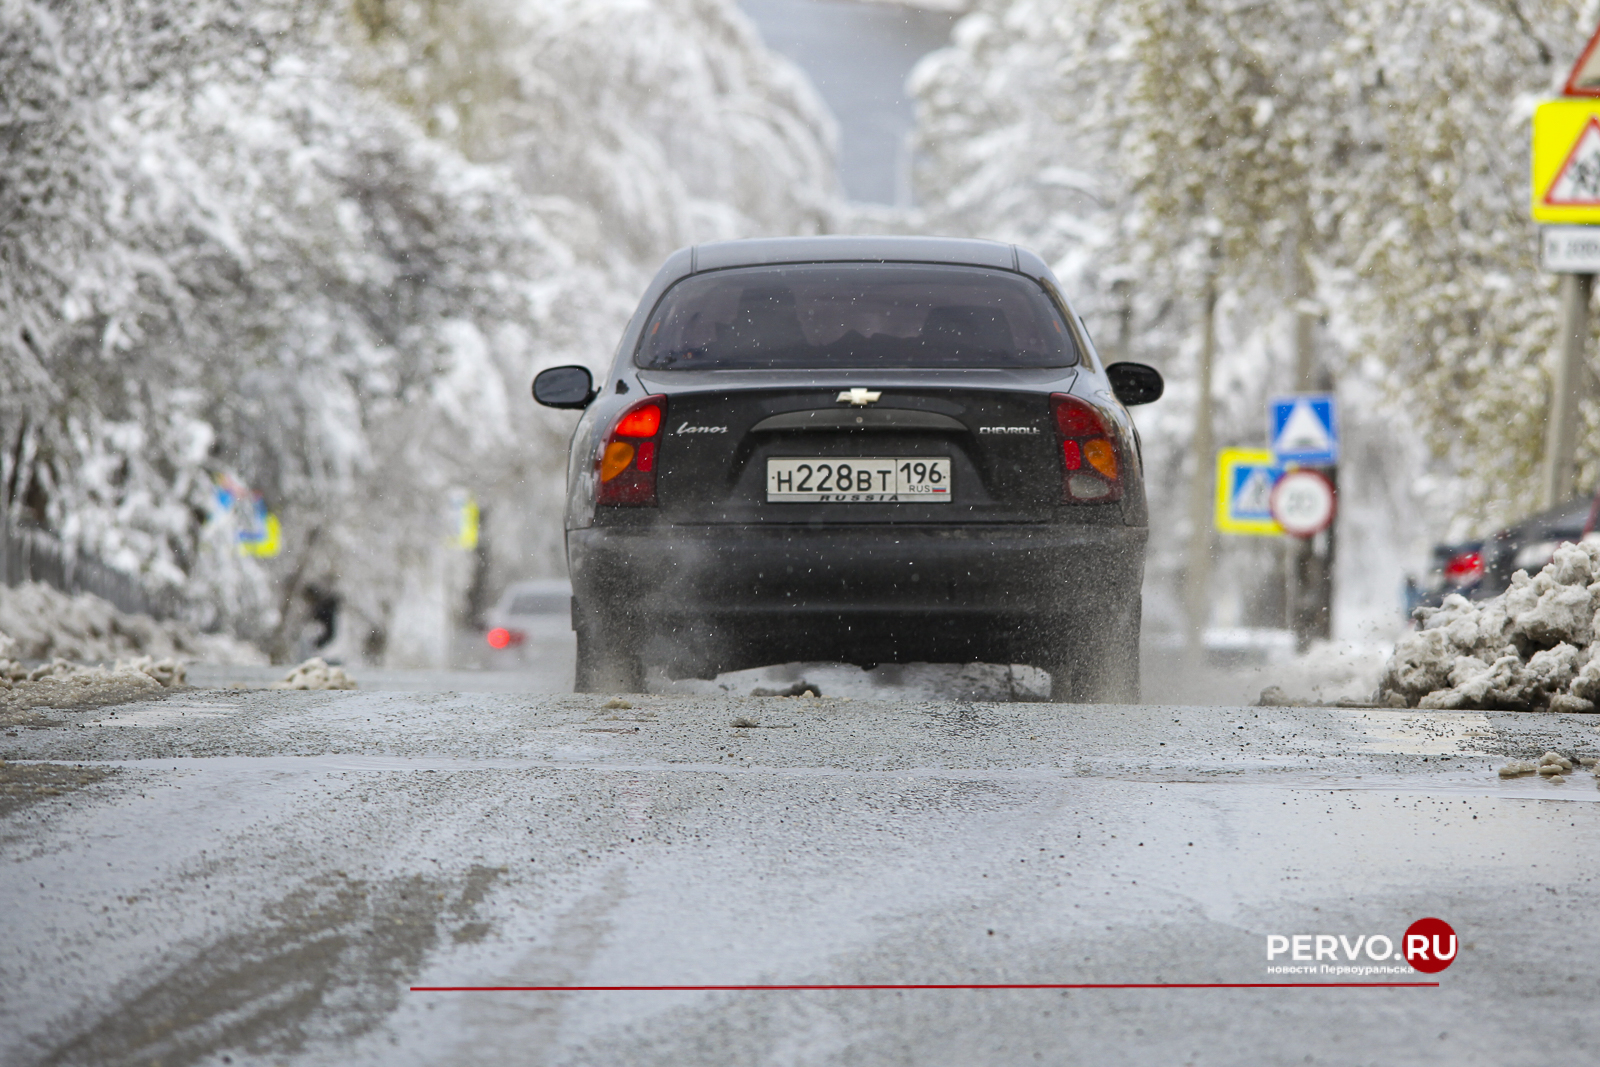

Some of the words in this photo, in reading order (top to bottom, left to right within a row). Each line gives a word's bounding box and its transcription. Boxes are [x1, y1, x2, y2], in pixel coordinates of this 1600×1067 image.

[899, 462, 943, 484] 196
[908, 485, 931, 493] RUS
[819, 494, 899, 502] RUSSIA
